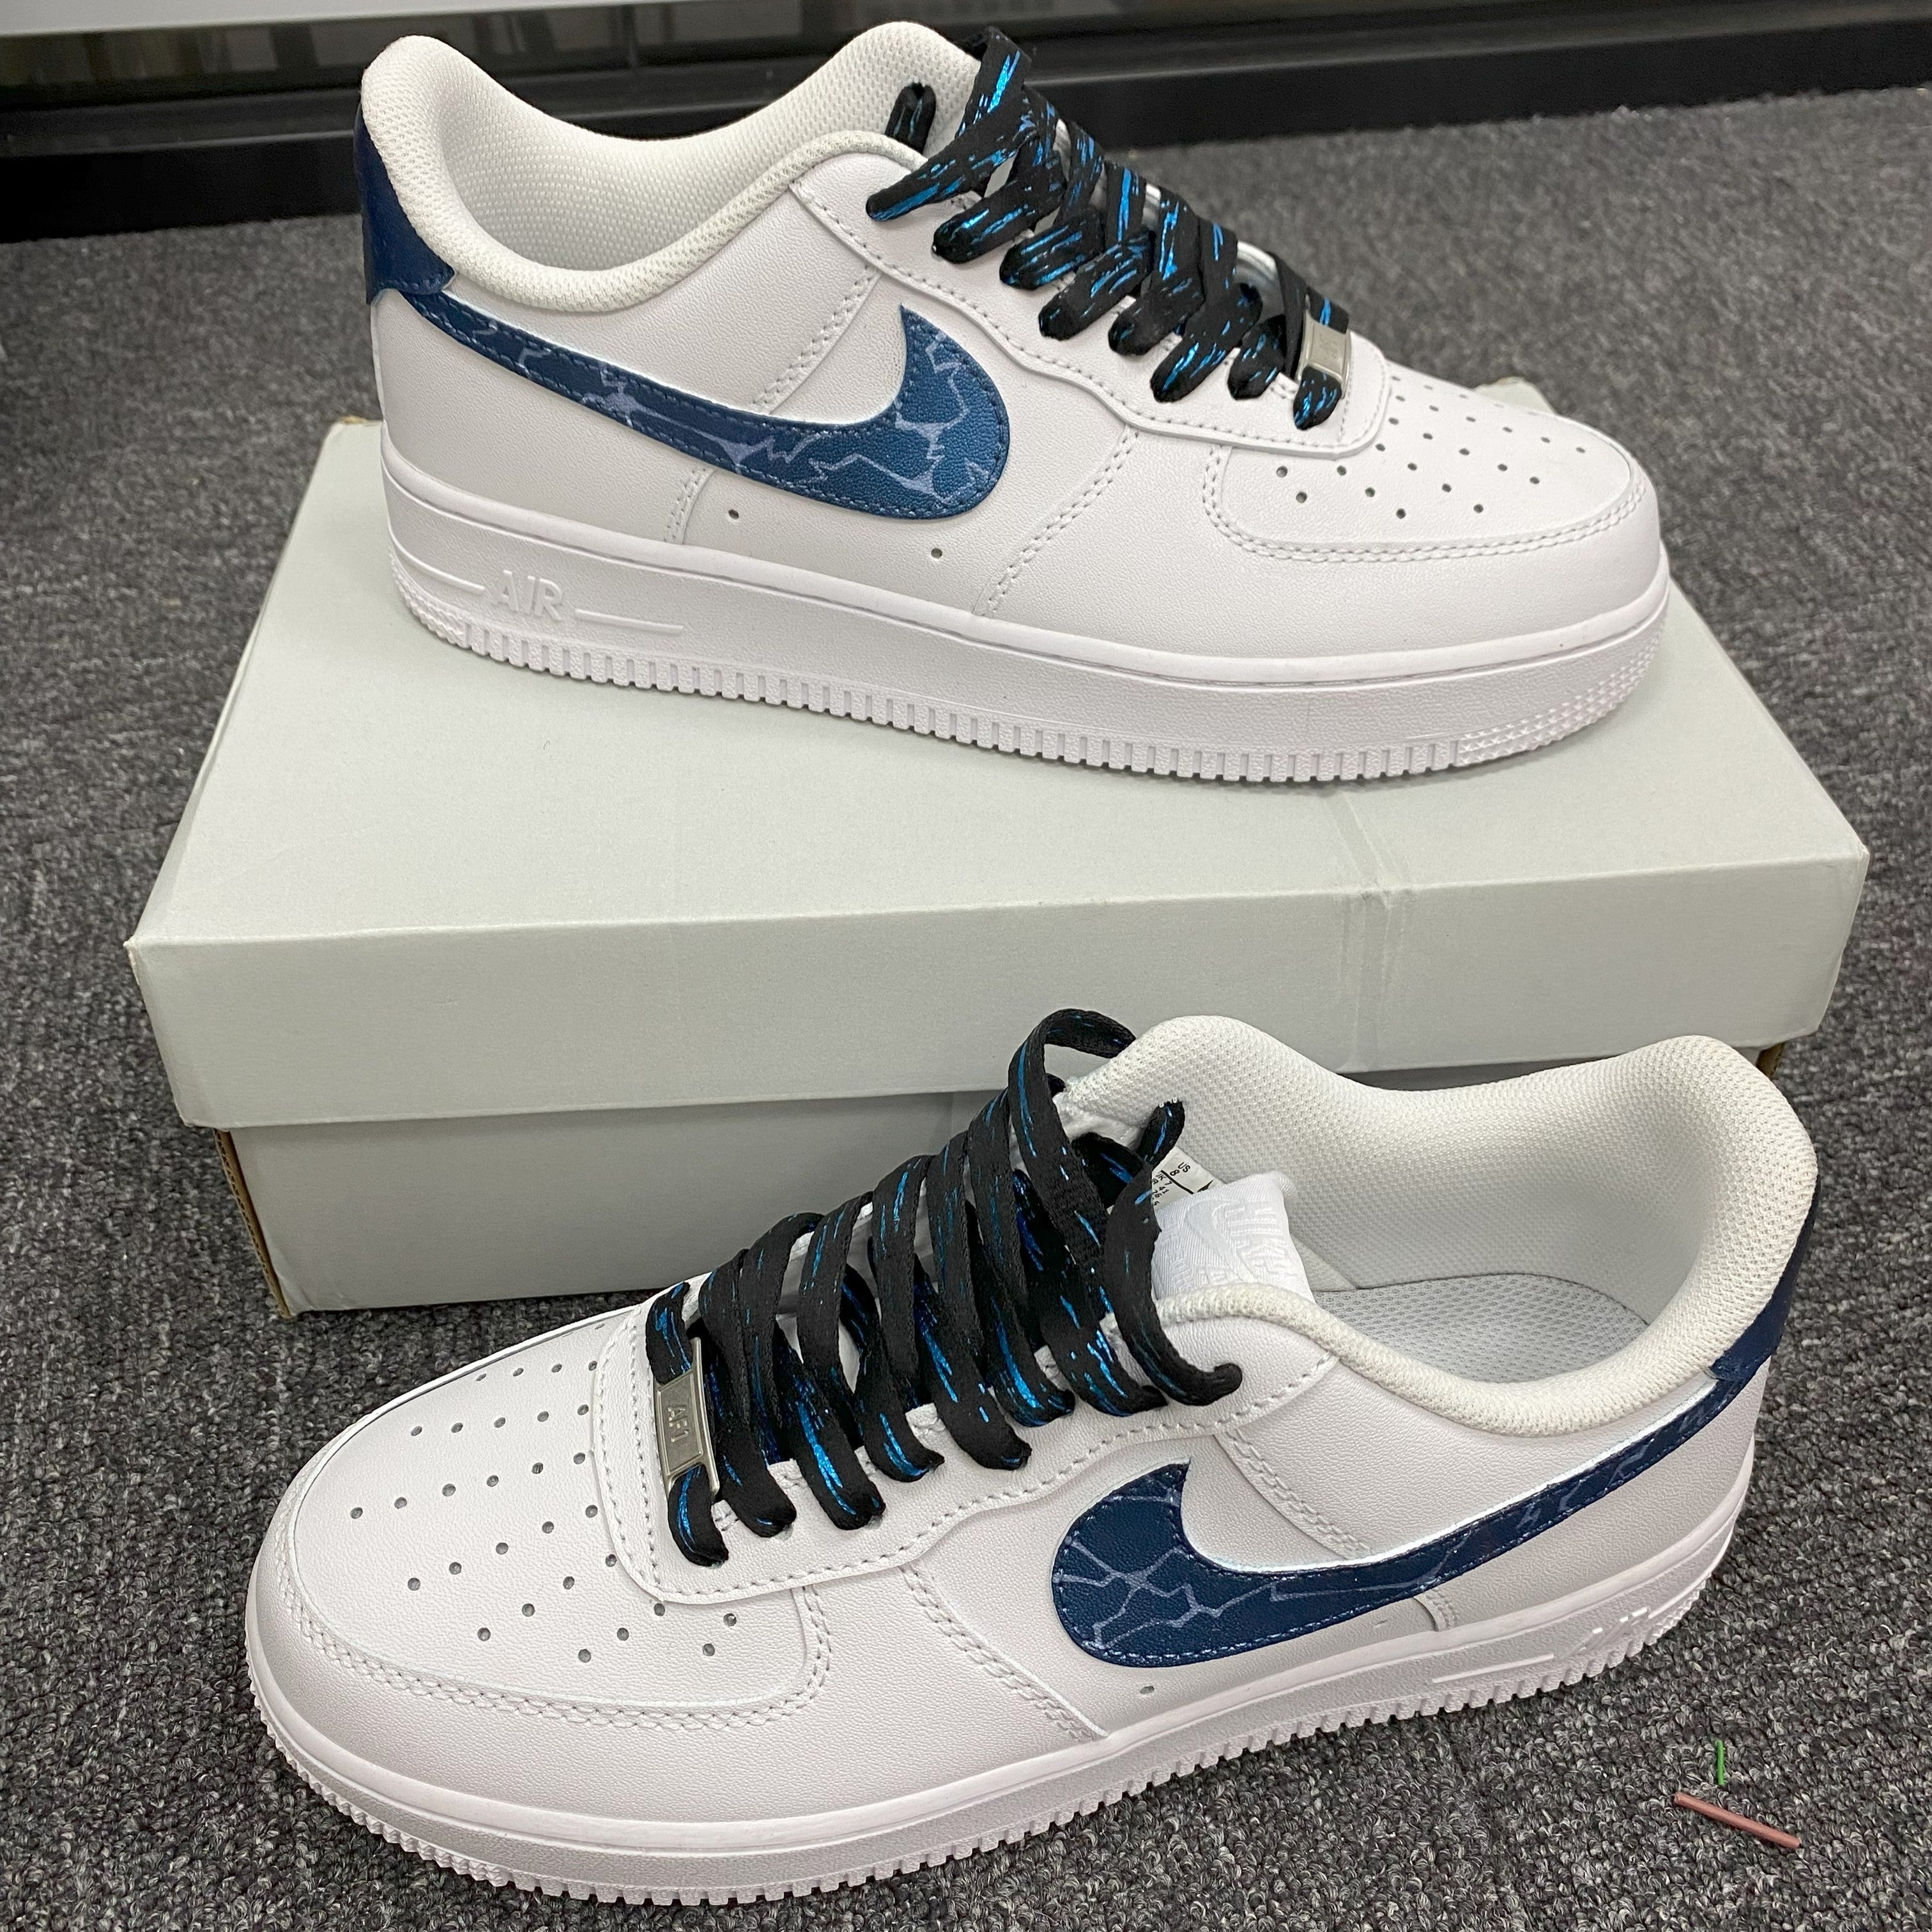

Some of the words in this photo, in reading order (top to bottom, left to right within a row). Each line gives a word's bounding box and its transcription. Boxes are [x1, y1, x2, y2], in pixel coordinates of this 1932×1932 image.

[497, 569, 563, 621] AIR
[1177, 1162, 1190, 1172] US
[1159, 1186, 1169, 1194] 41
